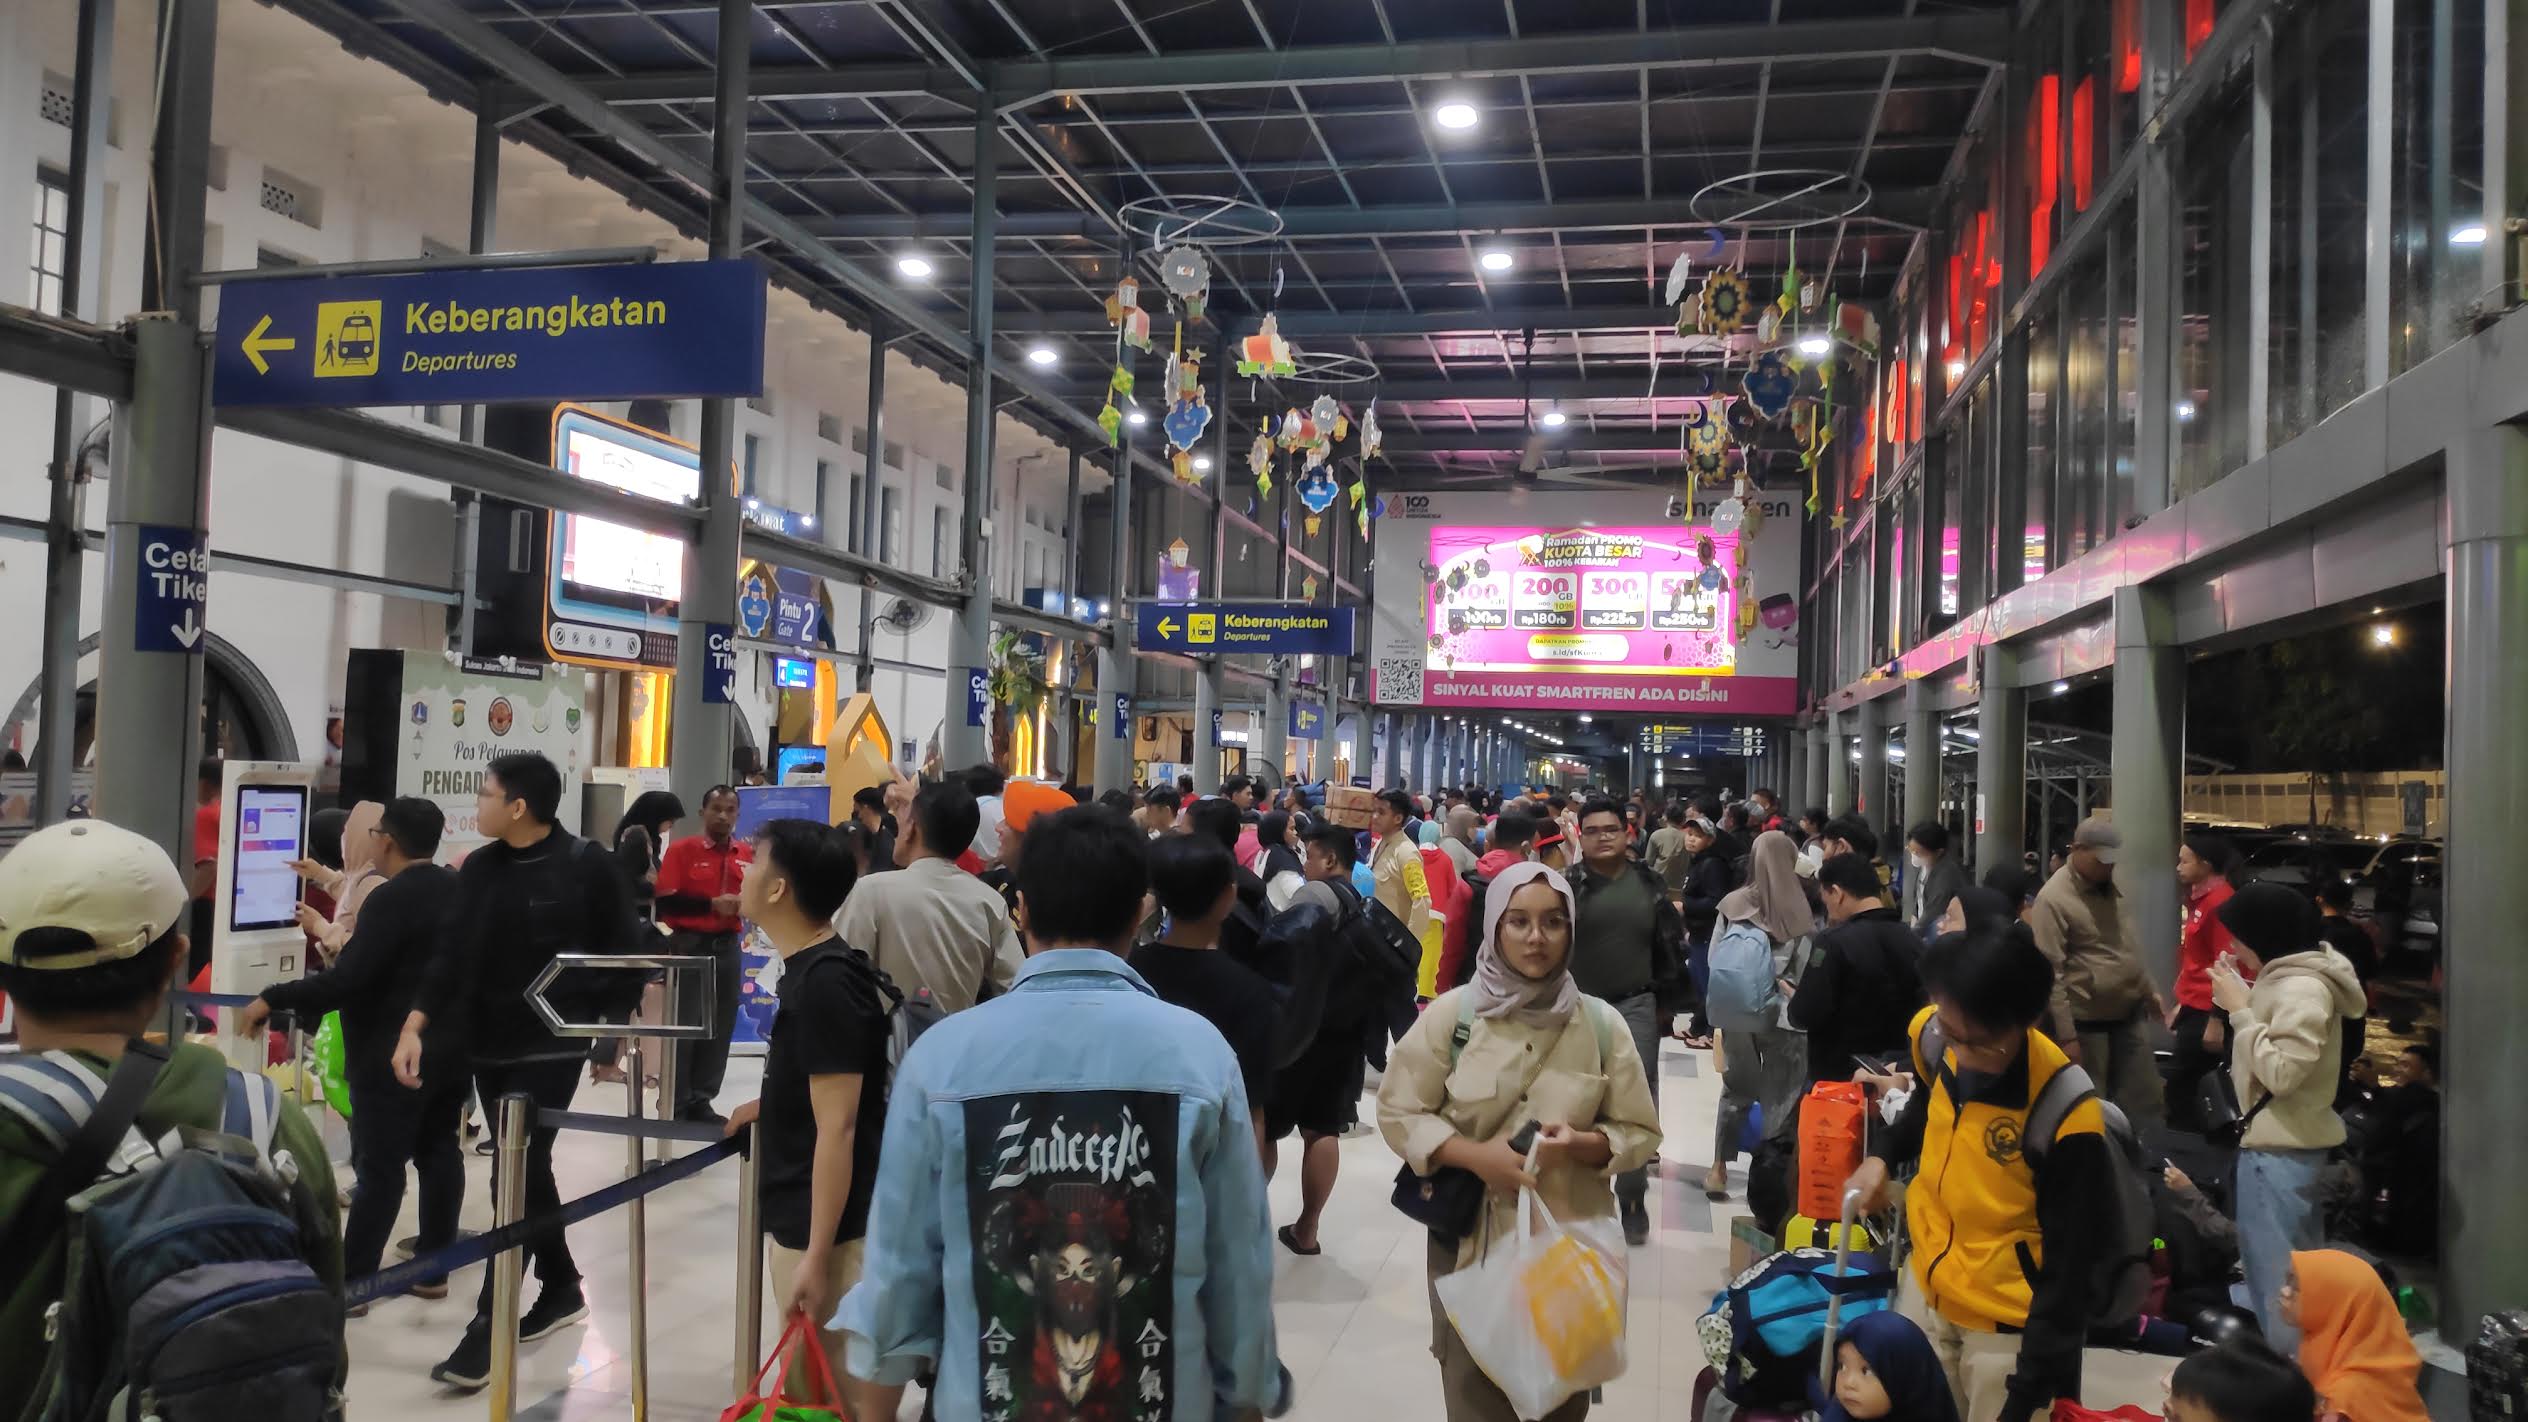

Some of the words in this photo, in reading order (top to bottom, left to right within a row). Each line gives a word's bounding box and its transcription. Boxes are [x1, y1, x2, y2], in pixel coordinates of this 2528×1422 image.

[406, 295, 666, 336] Keberangkatan
[402, 351, 517, 376] Departures
[1405, 496, 1430, 507] 100
[1546, 536, 1599, 547] Ramadan
[1600, 535, 1643, 545] PROMO
[1545, 546, 1593, 559] KUOTA
[1595, 545, 1643, 557] BESAR
[1544, 559, 1573, 567] 100%
[1522, 577, 1570, 595] 200
[1591, 578, 1639, 595] 300
[1558, 592, 1574, 600] GB
[780, 598, 802, 619] Pintu
[801, 602, 815, 642] 2
[1224, 614, 1328, 631] Keberangkatan
[1521, 612, 1568, 625] Rp180rb
[778, 622, 793, 637] Gate
[1223, 631, 1271, 642] Departures
[1433, 683, 1487, 697] SINYAL
[1491, 684, 1534, 698] KUAT
[1536, 685, 1635, 700] SMARTFREN
[1639, 688, 1675, 701] ADA
[1678, 689, 1728, 702] DISINI
[454, 740, 475, 760] Pos
[981, 1316, 1016, 1422] 合氣
[1135, 1318, 1168, 1422] 合氣
